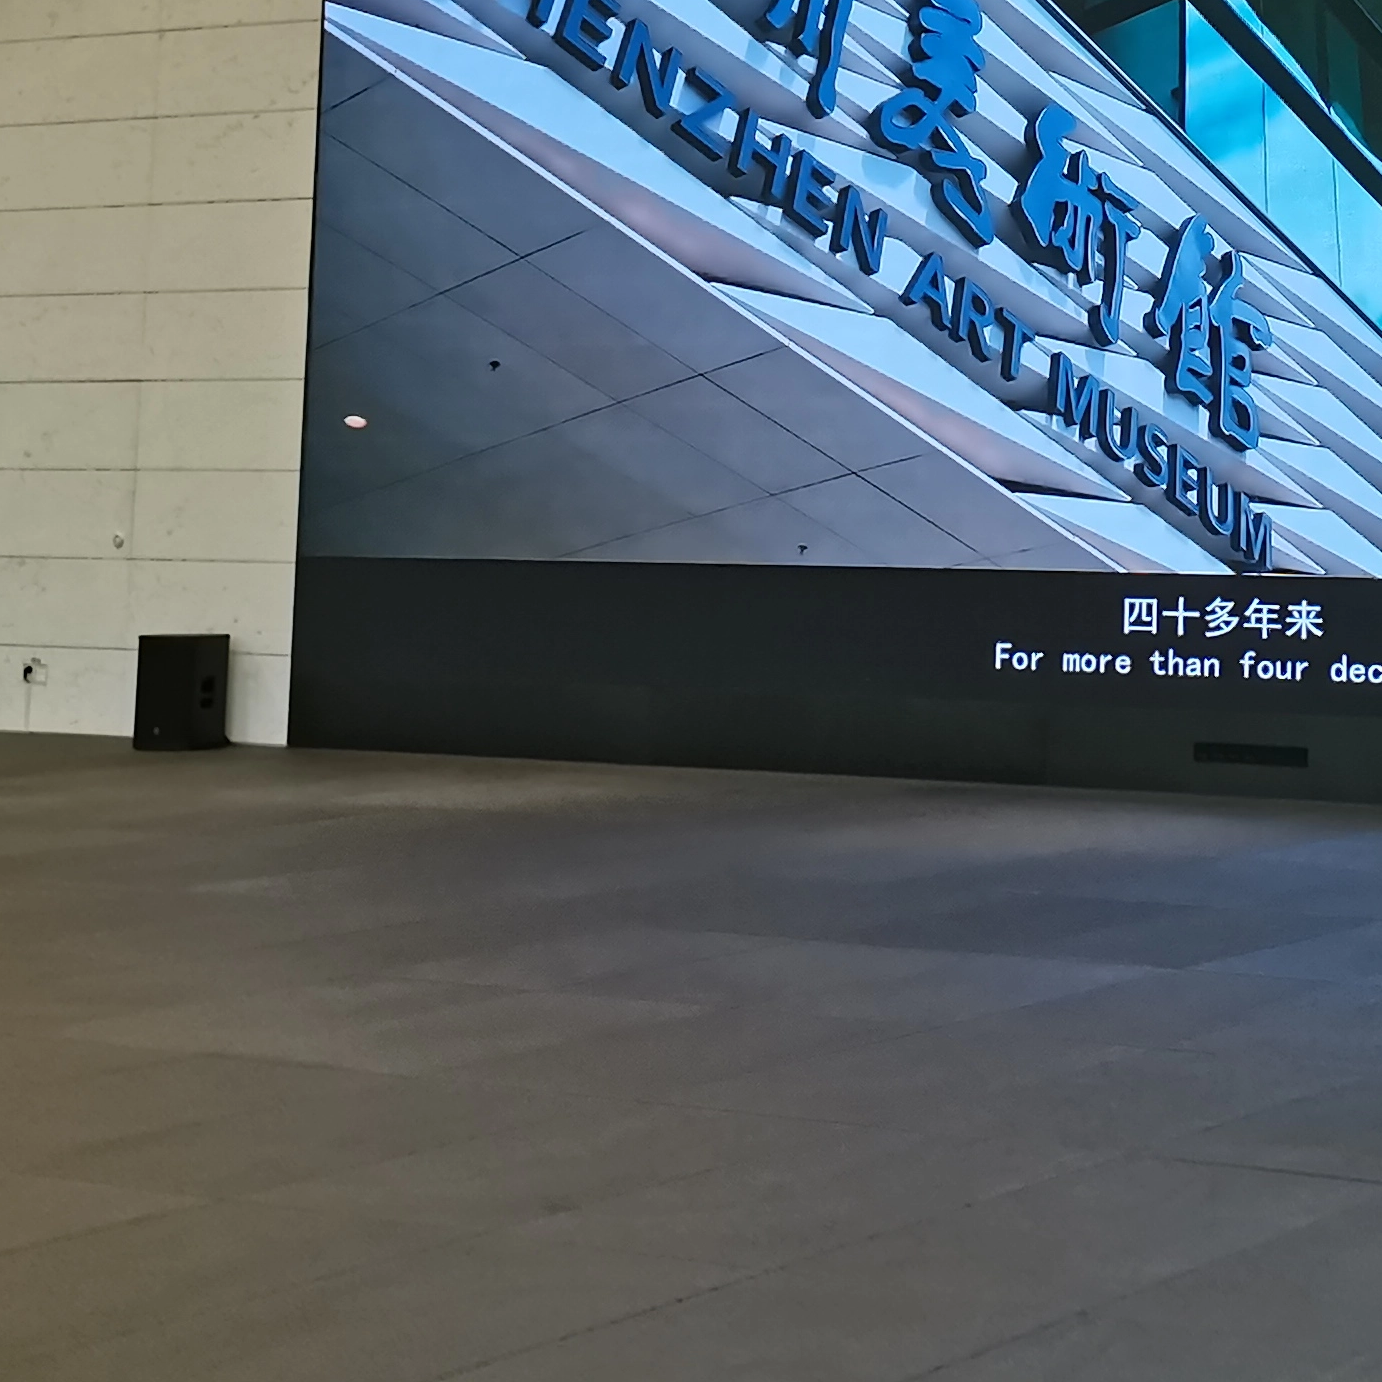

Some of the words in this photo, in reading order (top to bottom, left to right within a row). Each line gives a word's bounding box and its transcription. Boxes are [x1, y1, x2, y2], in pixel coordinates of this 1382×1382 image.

[900, 251, 1035, 381] ART
[1048, 351, 1273, 572] MUSEUM
[1121, 595, 1325, 640] 四十多年来
[994, 641, 1044, 672] For
[1062, 650, 1132, 674] more
[1150, 648, 1220, 678] than
[1239, 650, 1309, 682] four
